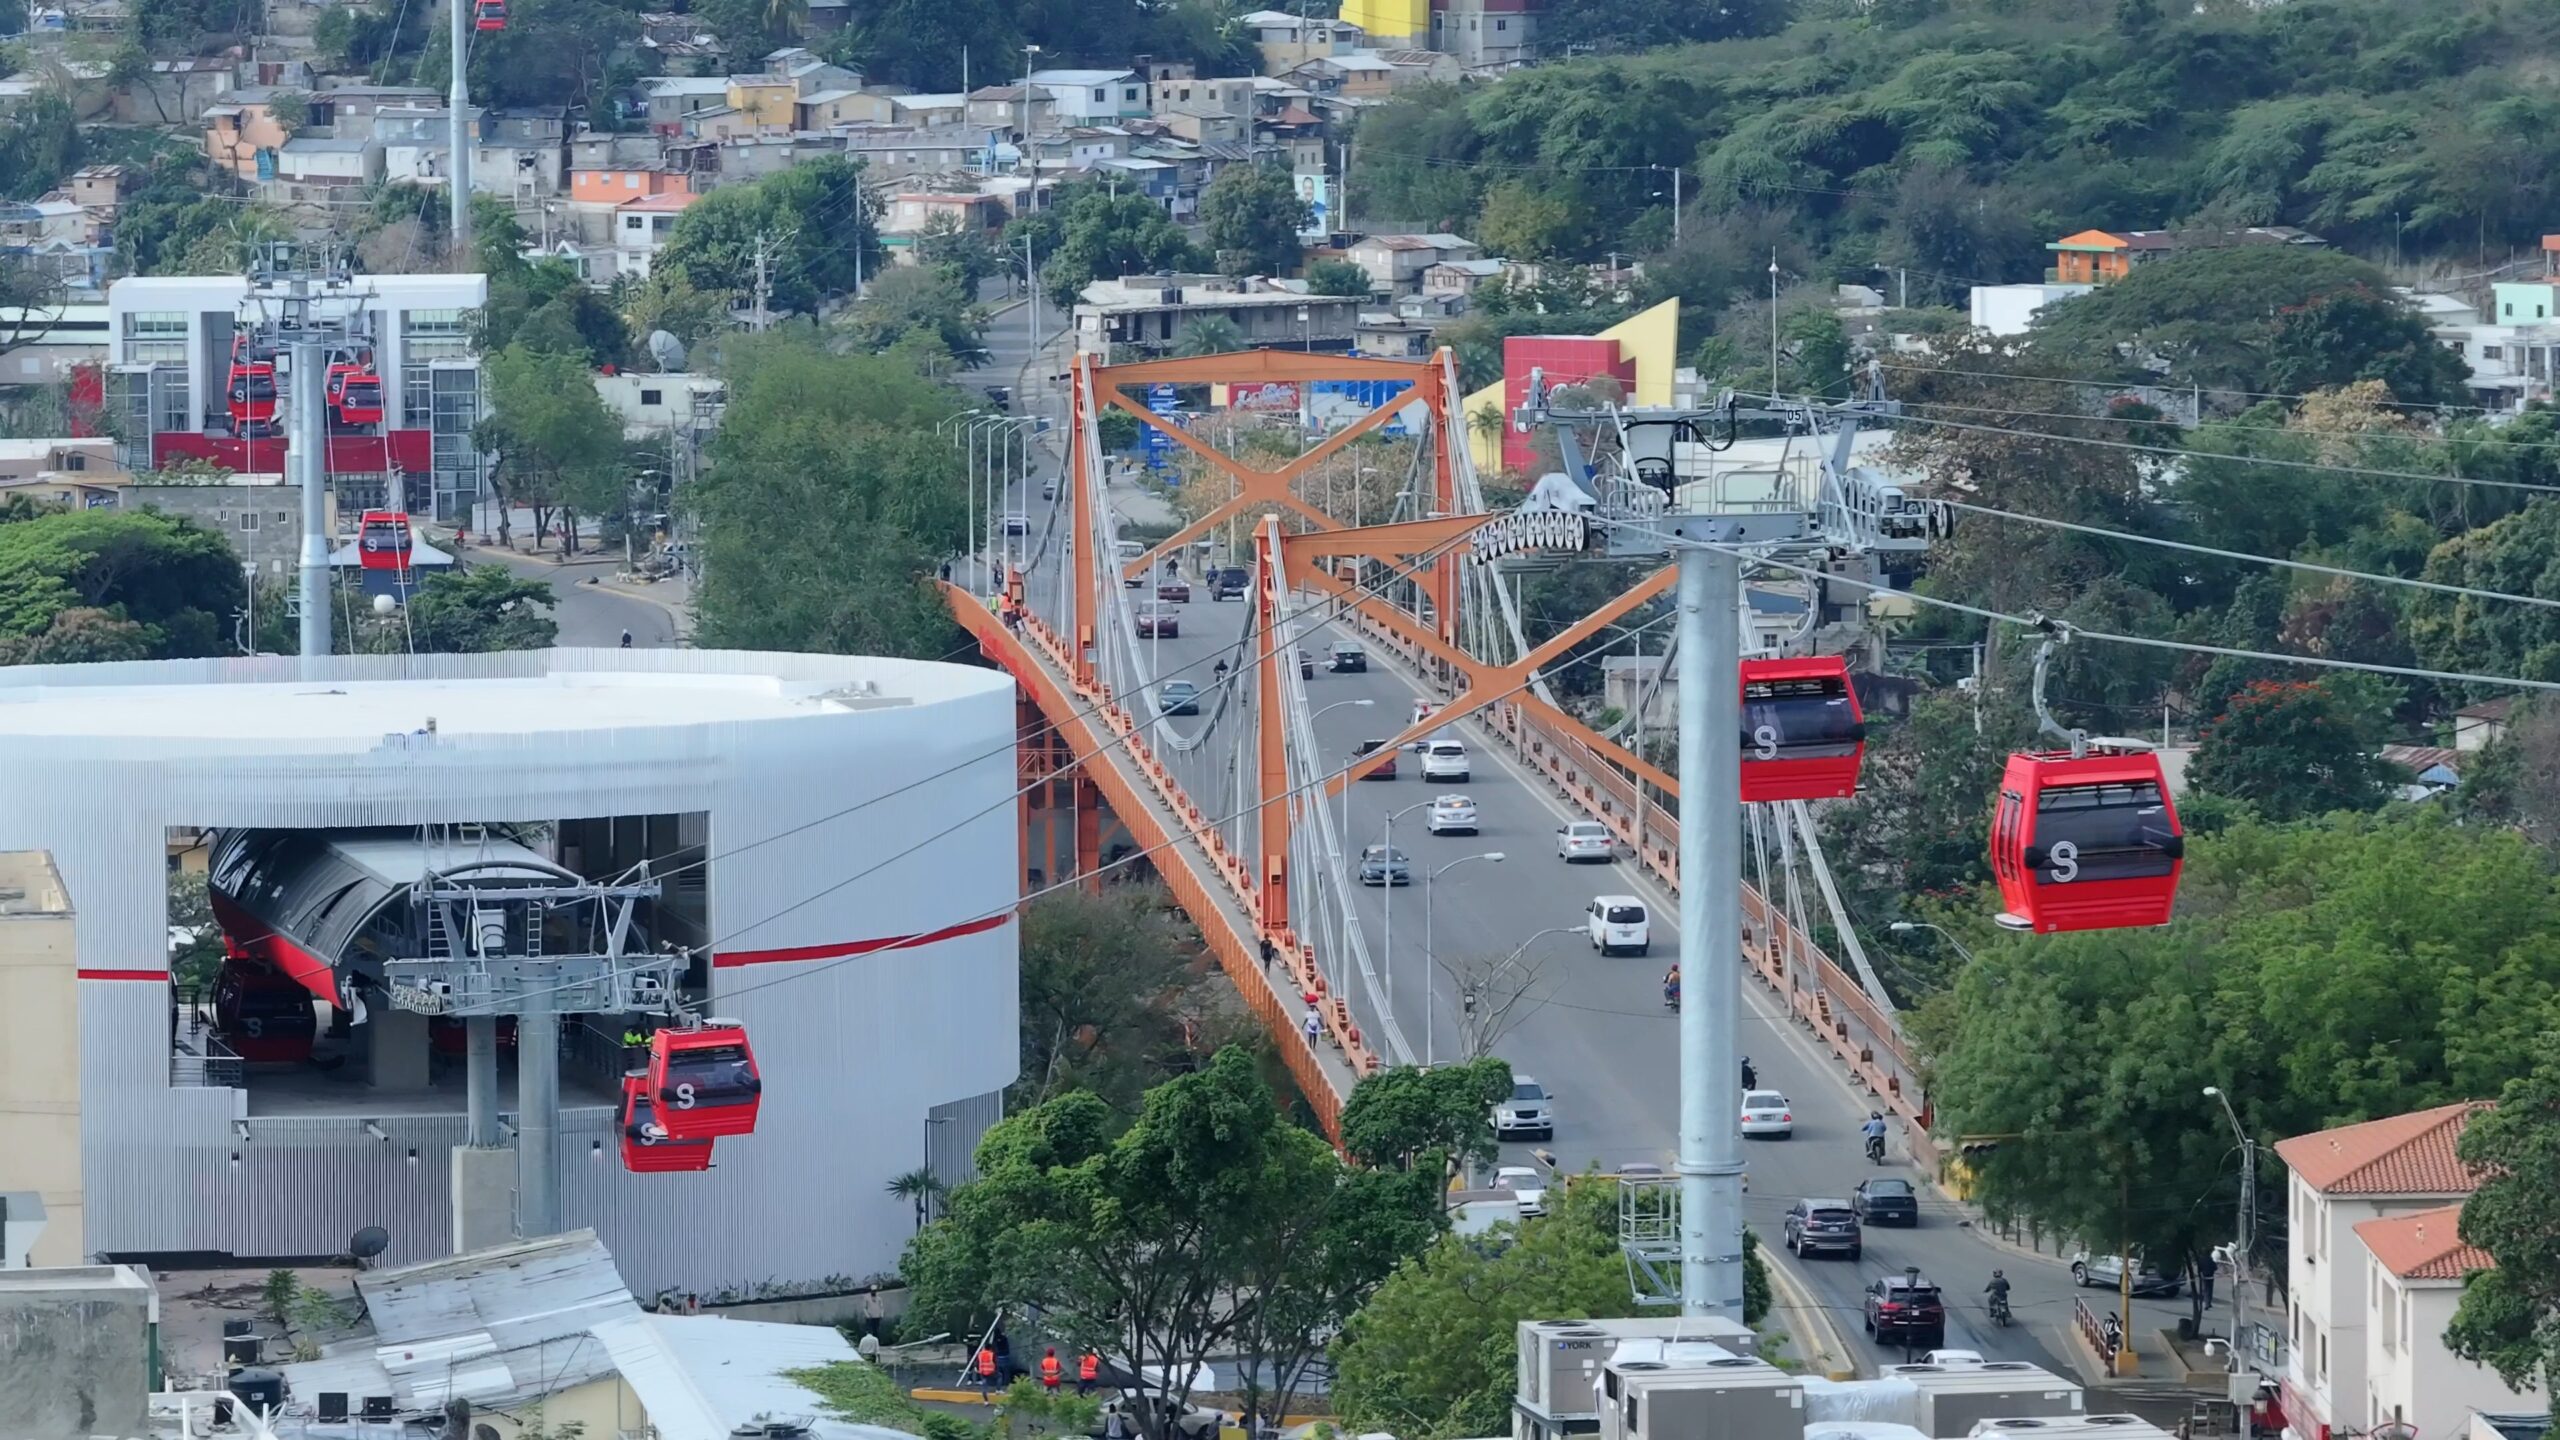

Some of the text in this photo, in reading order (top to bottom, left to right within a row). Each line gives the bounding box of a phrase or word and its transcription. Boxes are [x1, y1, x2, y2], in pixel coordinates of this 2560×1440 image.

[333, 383, 340, 394] S
[235, 389, 245, 403] S
[347, 396, 356, 409] S
[1787, 410, 1801, 421] 05
[367, 538, 378, 552] S
[1754, 725, 1777, 760] S
[2050, 840, 2078, 883] S
[676, 1082, 695, 1110] S
[640, 1122, 656, 1146] S
[1567, 1341, 1592, 1350] YORK
